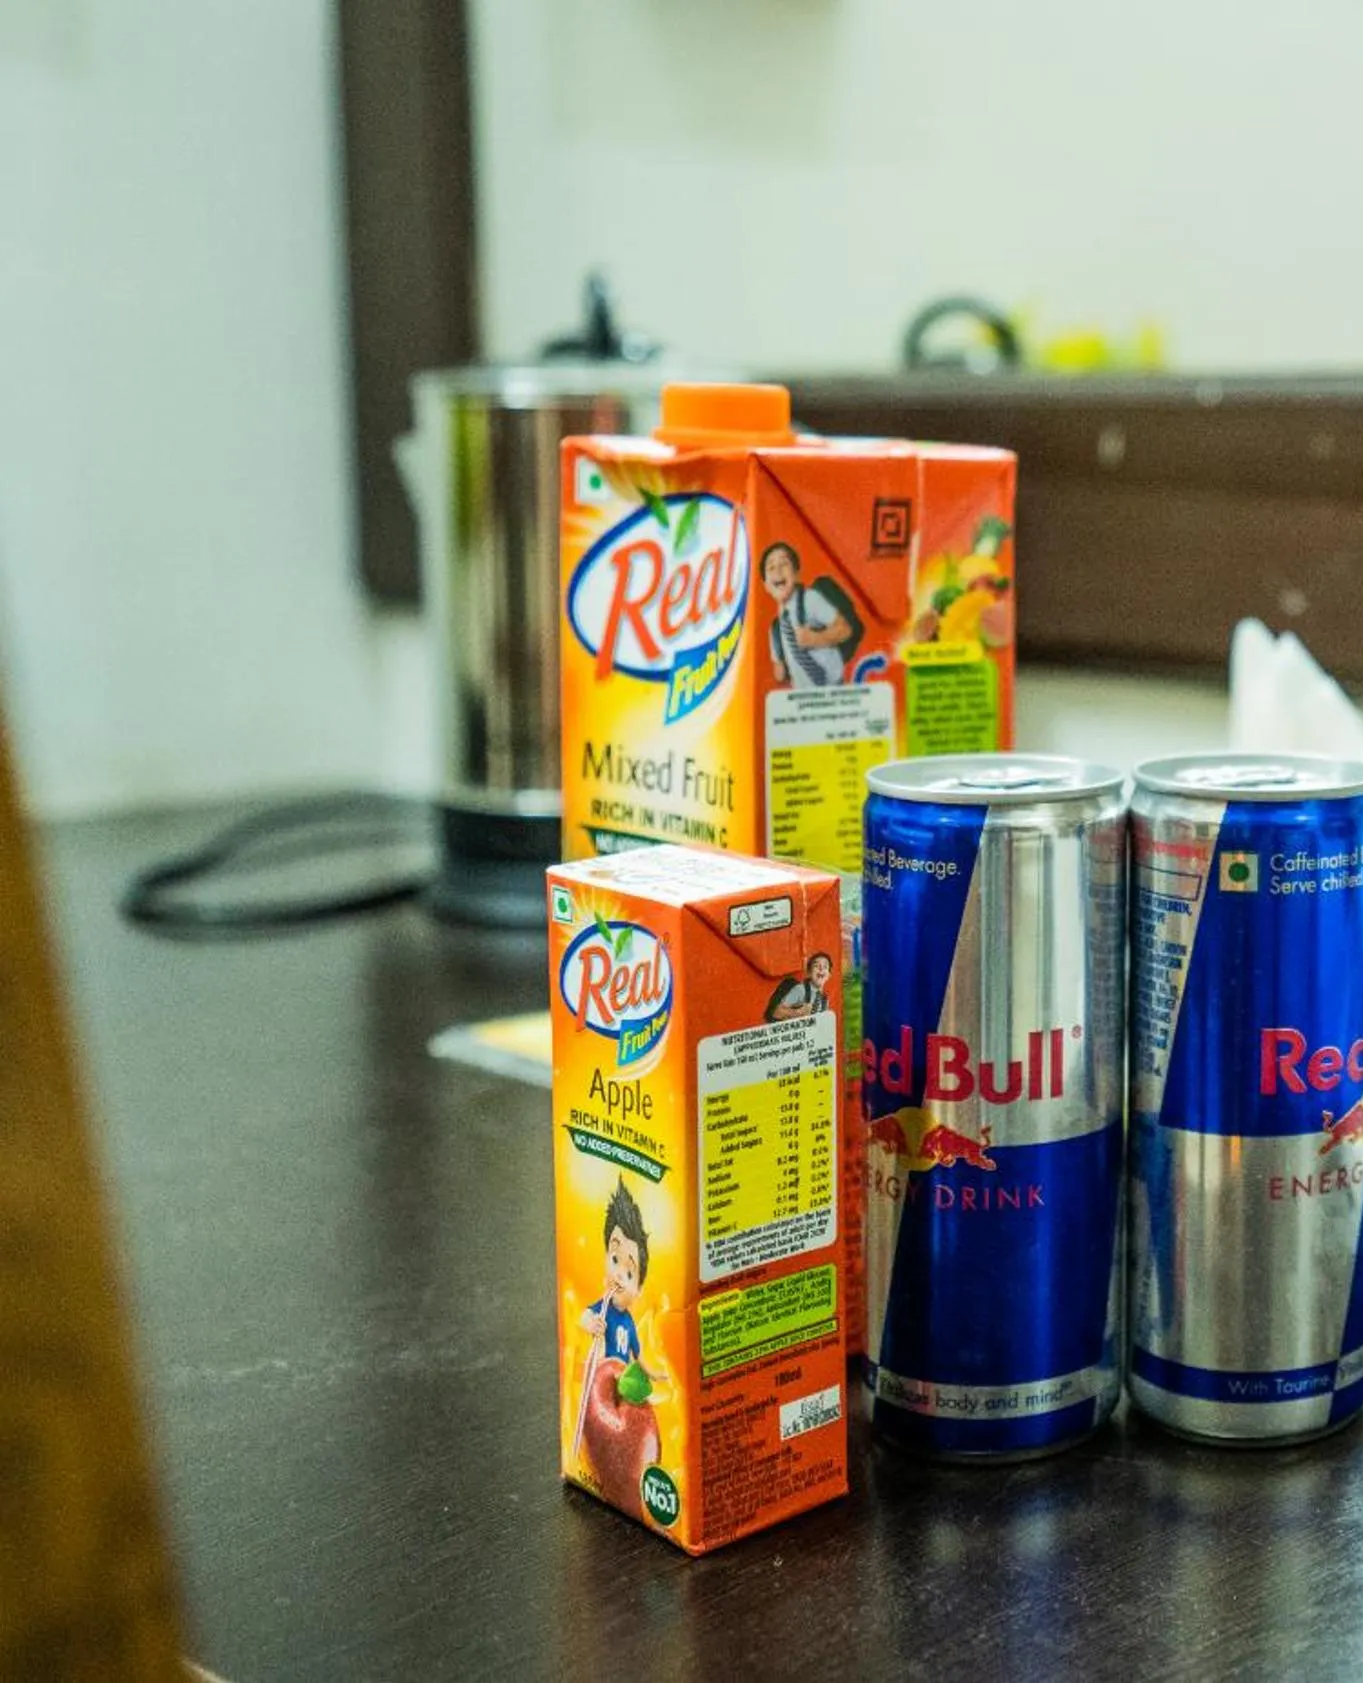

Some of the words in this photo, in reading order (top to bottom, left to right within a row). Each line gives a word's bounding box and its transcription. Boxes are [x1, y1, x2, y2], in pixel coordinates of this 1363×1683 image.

[595, 508, 742, 681] Real
[582, 741, 672, 794] Mixed
[682, 757, 733, 812] Fruit
[591, 799, 633, 821] RICH
[640, 804, 654, 826] IN
[661, 810, 716, 844] VITAMIN
[719, 827, 728, 849] C
[888, 848, 961, 880] Beverage.
[1270, 846, 1358, 872] Caffeinated
[1270, 877, 1316, 895] Serve
[576, 940, 665, 1032] Real
[862, 1025, 913, 1094] ed
[926, 1028, 1064, 1105] Bull
[589, 1068, 652, 1120] Apple
[570, 1109, 599, 1128] RICH
[602, 1119, 613, 1136] IN
[617, 1125, 657, 1154] VITAMIN
[659, 1144, 665, 1158] C
[935, 1183, 1046, 1212] DRINK
[935, 1390, 977, 1412] body
[985, 1391, 1018, 1409] and
[1228, 1379, 1269, 1396] With
[645, 1481, 676, 1515] No.1
